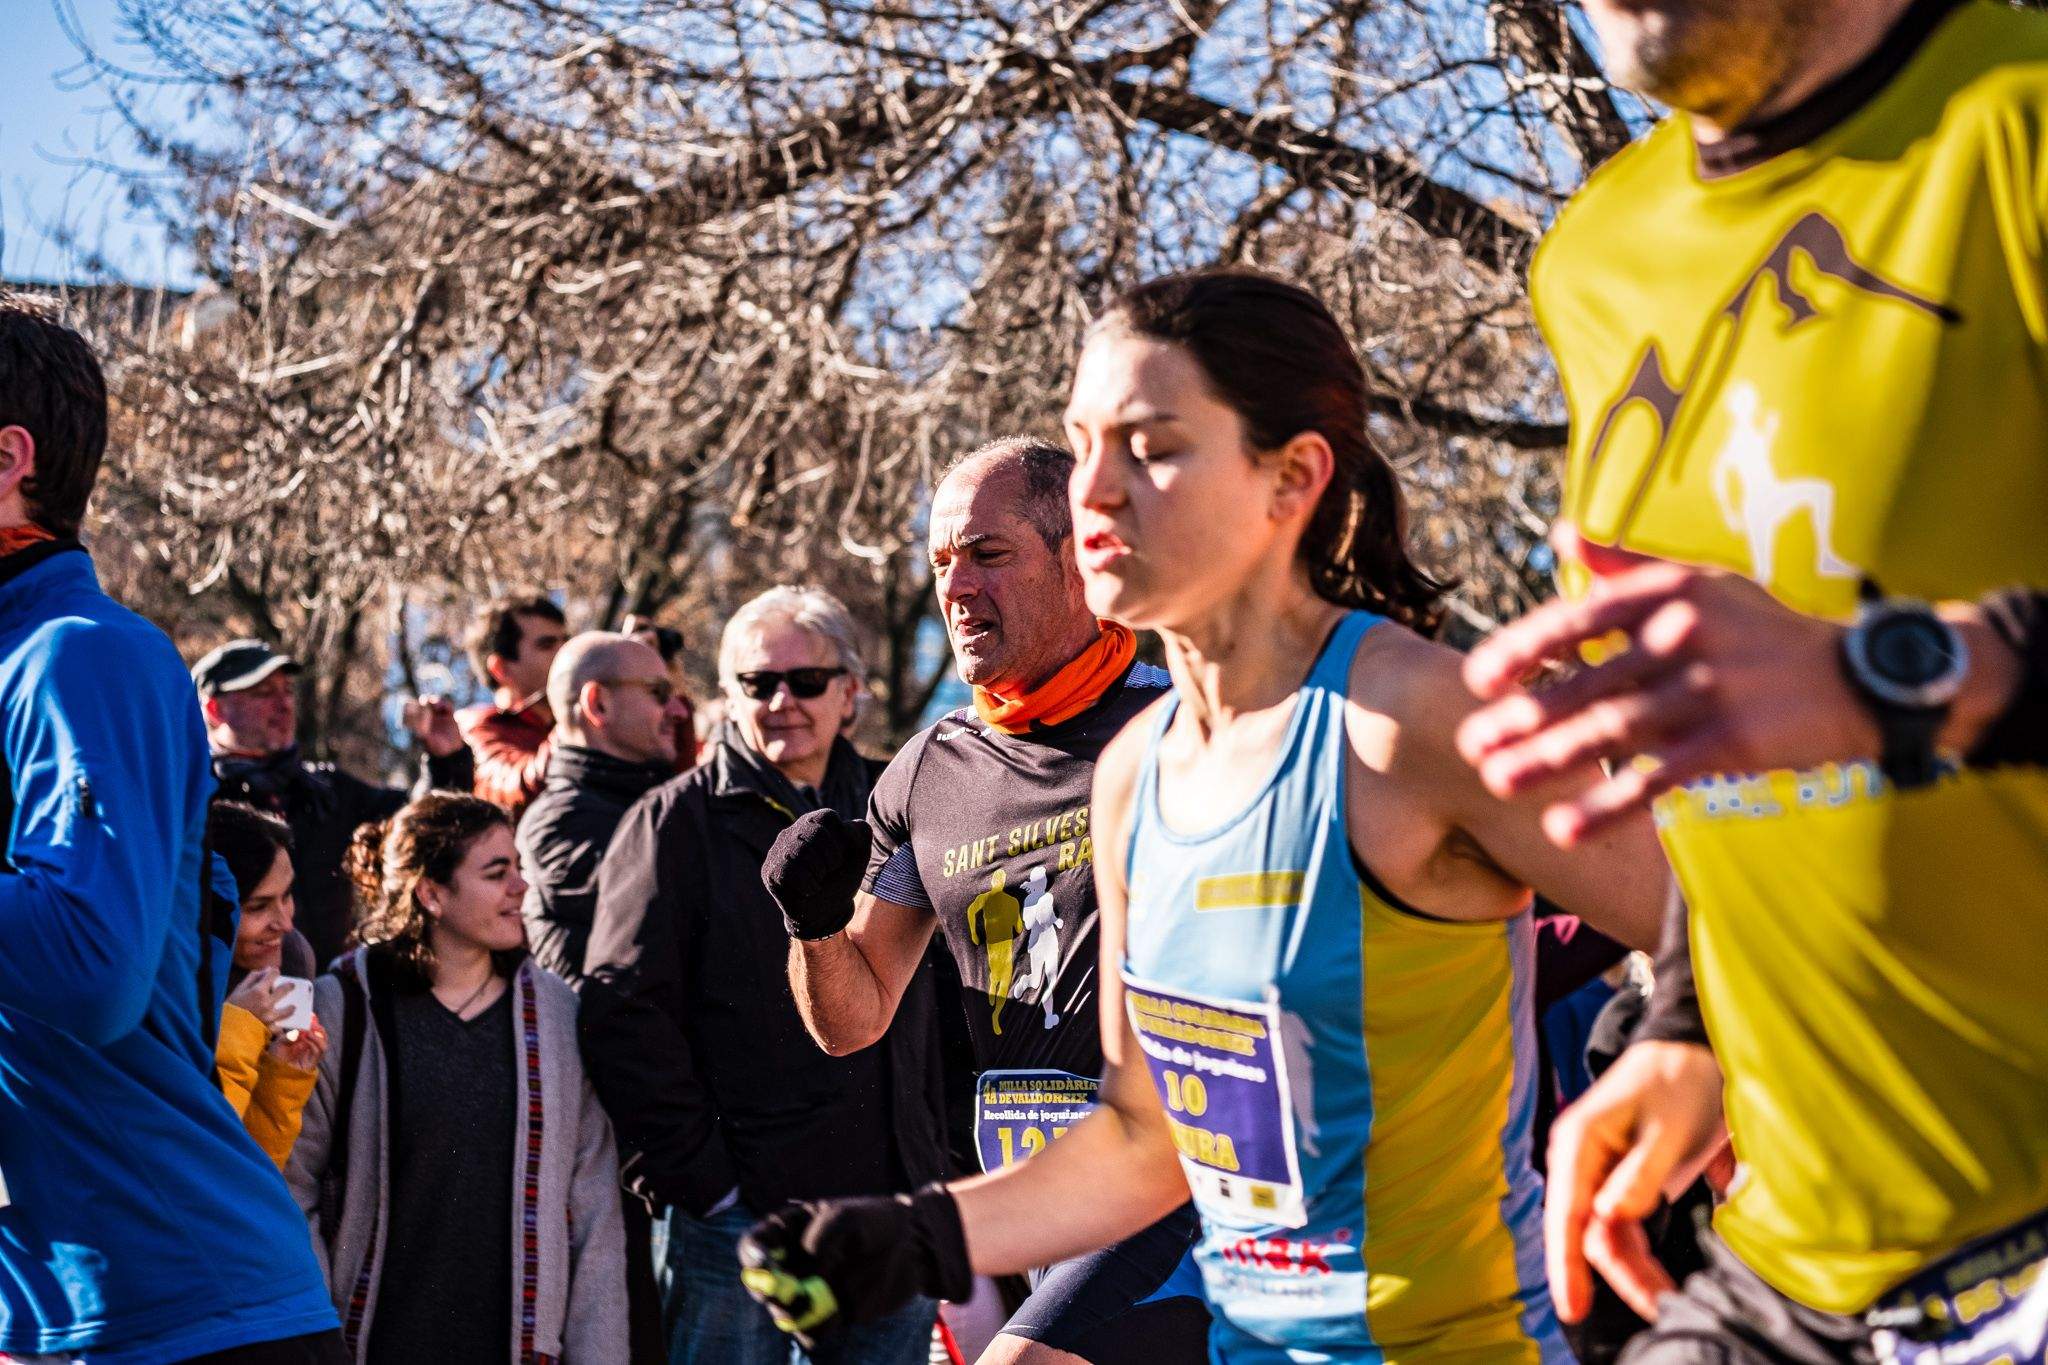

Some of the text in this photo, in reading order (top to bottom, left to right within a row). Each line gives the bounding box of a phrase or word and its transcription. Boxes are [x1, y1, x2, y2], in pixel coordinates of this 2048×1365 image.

[943, 807, 1089, 878] SANT SILVES
[1058, 836, 1094, 871] RA
[999, 1080, 1028, 1091] MILLA
[1163, 1070, 1208, 1117] 10
[984, 1109, 1027, 1121] Recollida
[1027, 1109, 1039, 1120] de
[997, 1126, 1068, 1169] 12
